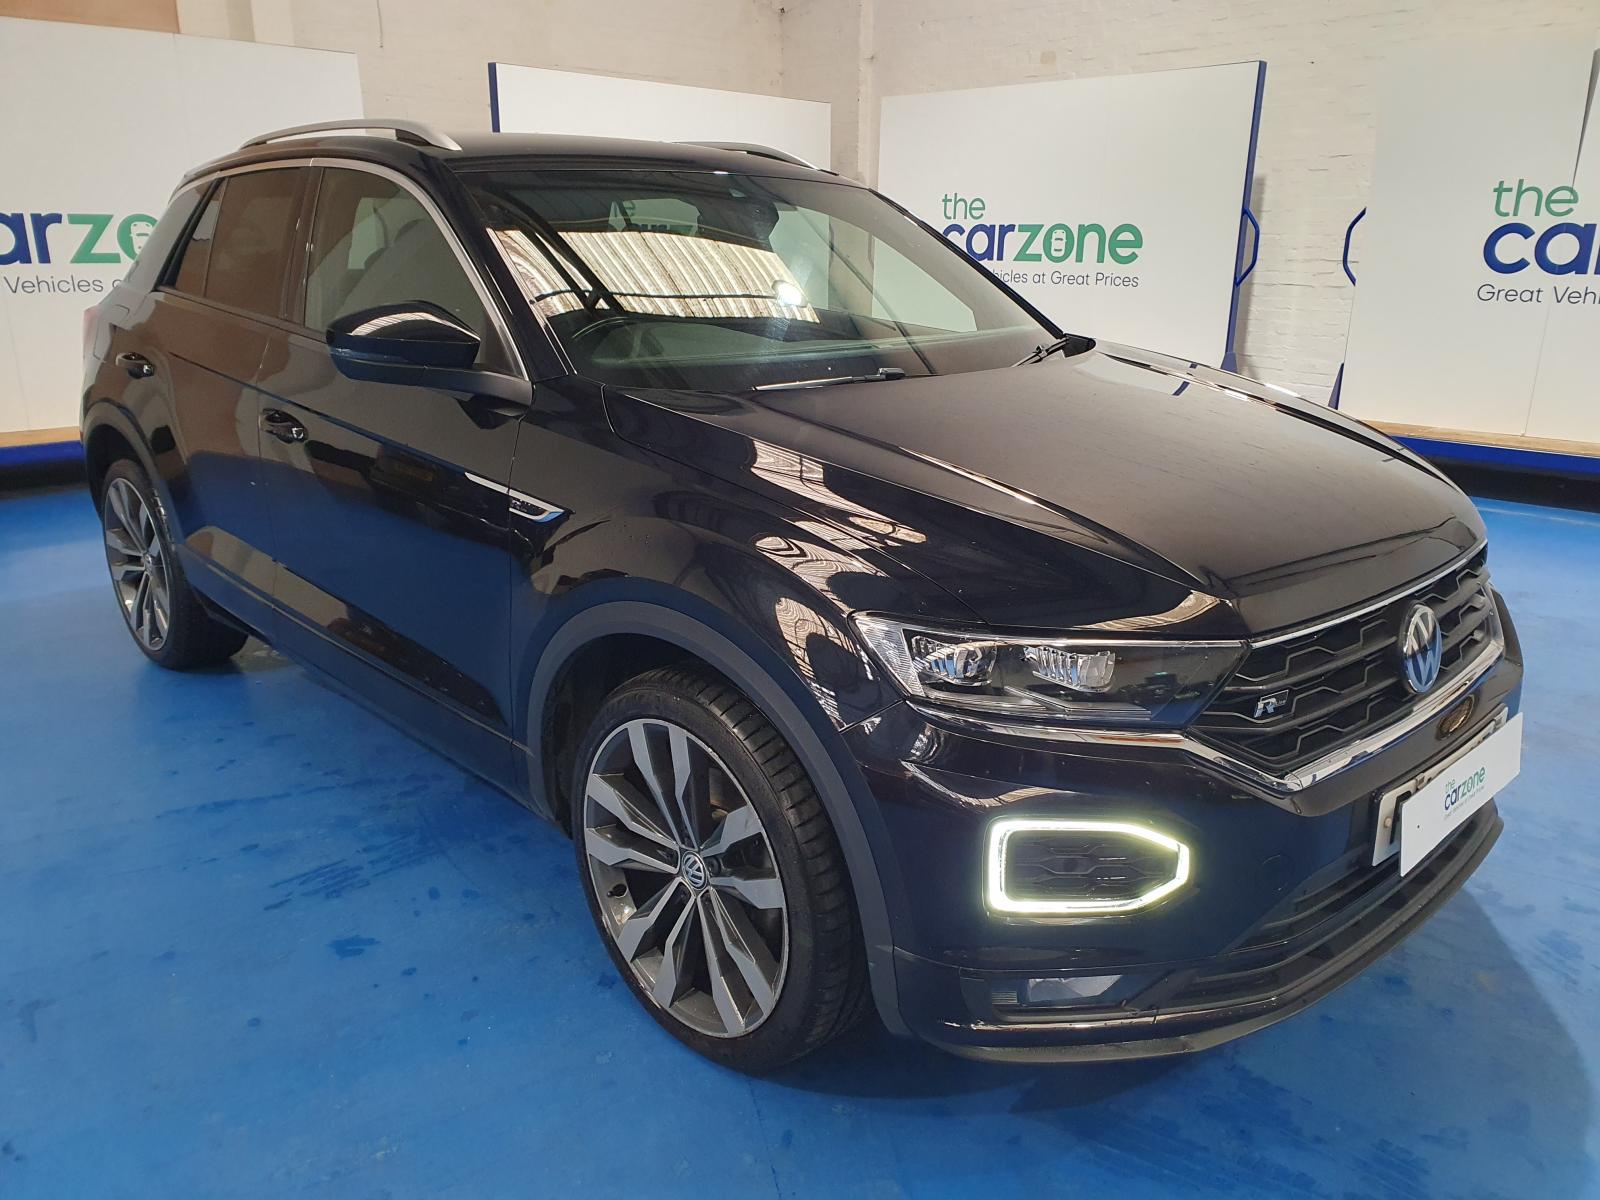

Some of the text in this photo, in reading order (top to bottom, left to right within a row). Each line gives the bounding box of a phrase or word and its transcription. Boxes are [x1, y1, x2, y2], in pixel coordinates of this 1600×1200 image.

[942, 193, 985, 220] the
[1493, 179, 1579, 217] the
[0, 213, 159, 265] arzo
[1483, 222, 1600, 275] ca
[3, 275, 104, 293] Vehicles
[1032, 272, 1046, 284] at
[1050, 271, 1089, 286] Great
[1095, 272, 1139, 287] Prices
[1477, 283, 1600, 304] Great Veh
[1444, 766, 1486, 811] carzone
[1445, 778, 1456, 793] the
